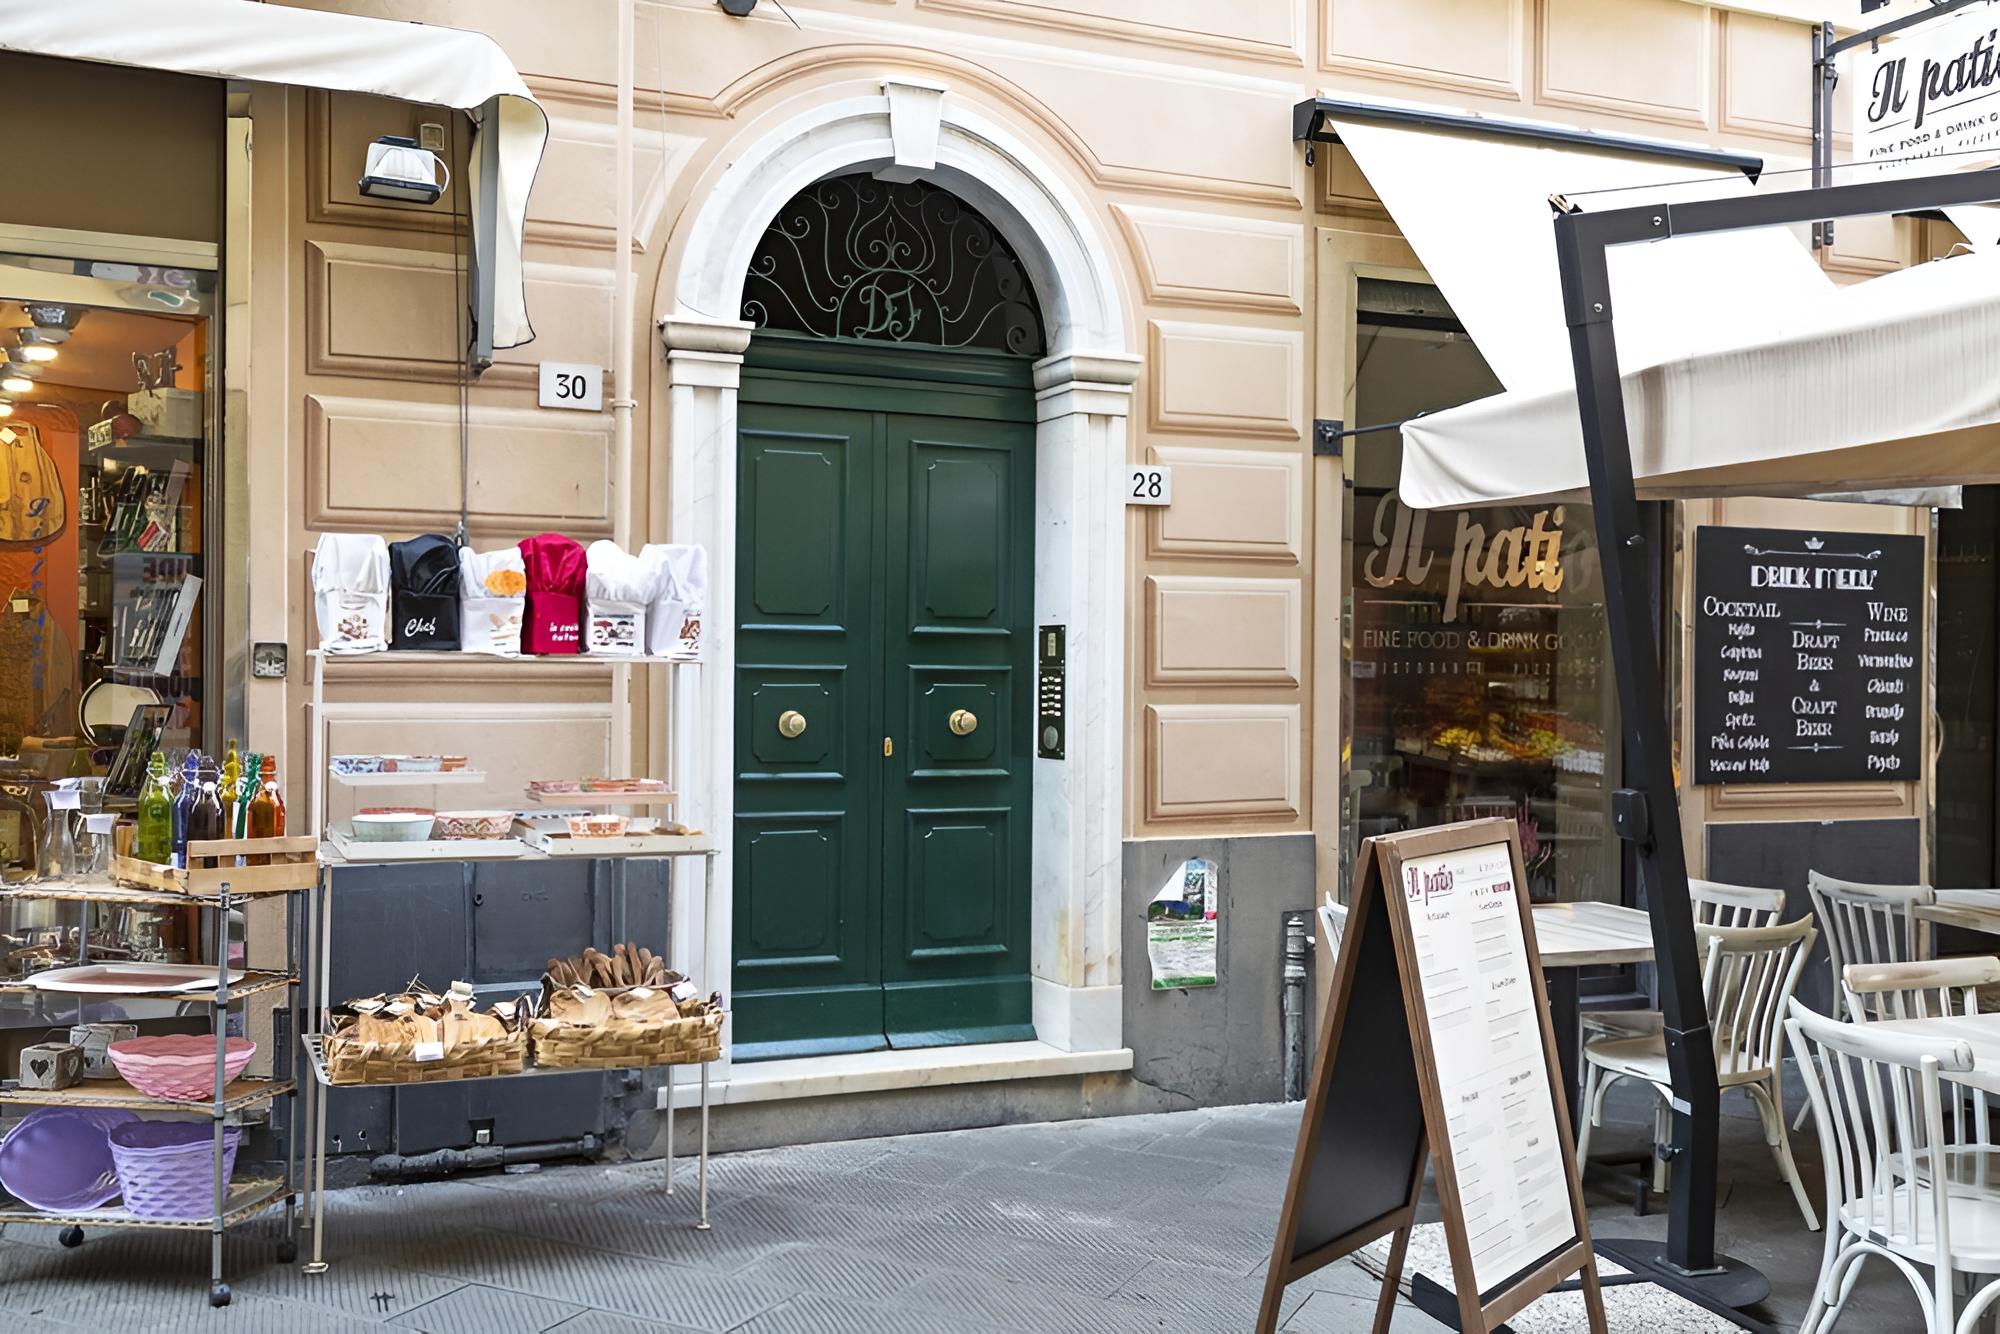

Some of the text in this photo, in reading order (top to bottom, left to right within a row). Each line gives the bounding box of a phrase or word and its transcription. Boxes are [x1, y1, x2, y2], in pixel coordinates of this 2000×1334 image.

[1868, 57, 1909, 122] Il
[556, 374, 586, 399] 30
[1133, 472, 1162, 498] 28
[1751, 565, 1810, 588] DRINK
[1363, 631, 1400, 649] FINE
[1408, 631, 1460, 649] FOOD
[1467, 630, 1481, 649] &
[1488, 632, 1539, 650] DRINK
